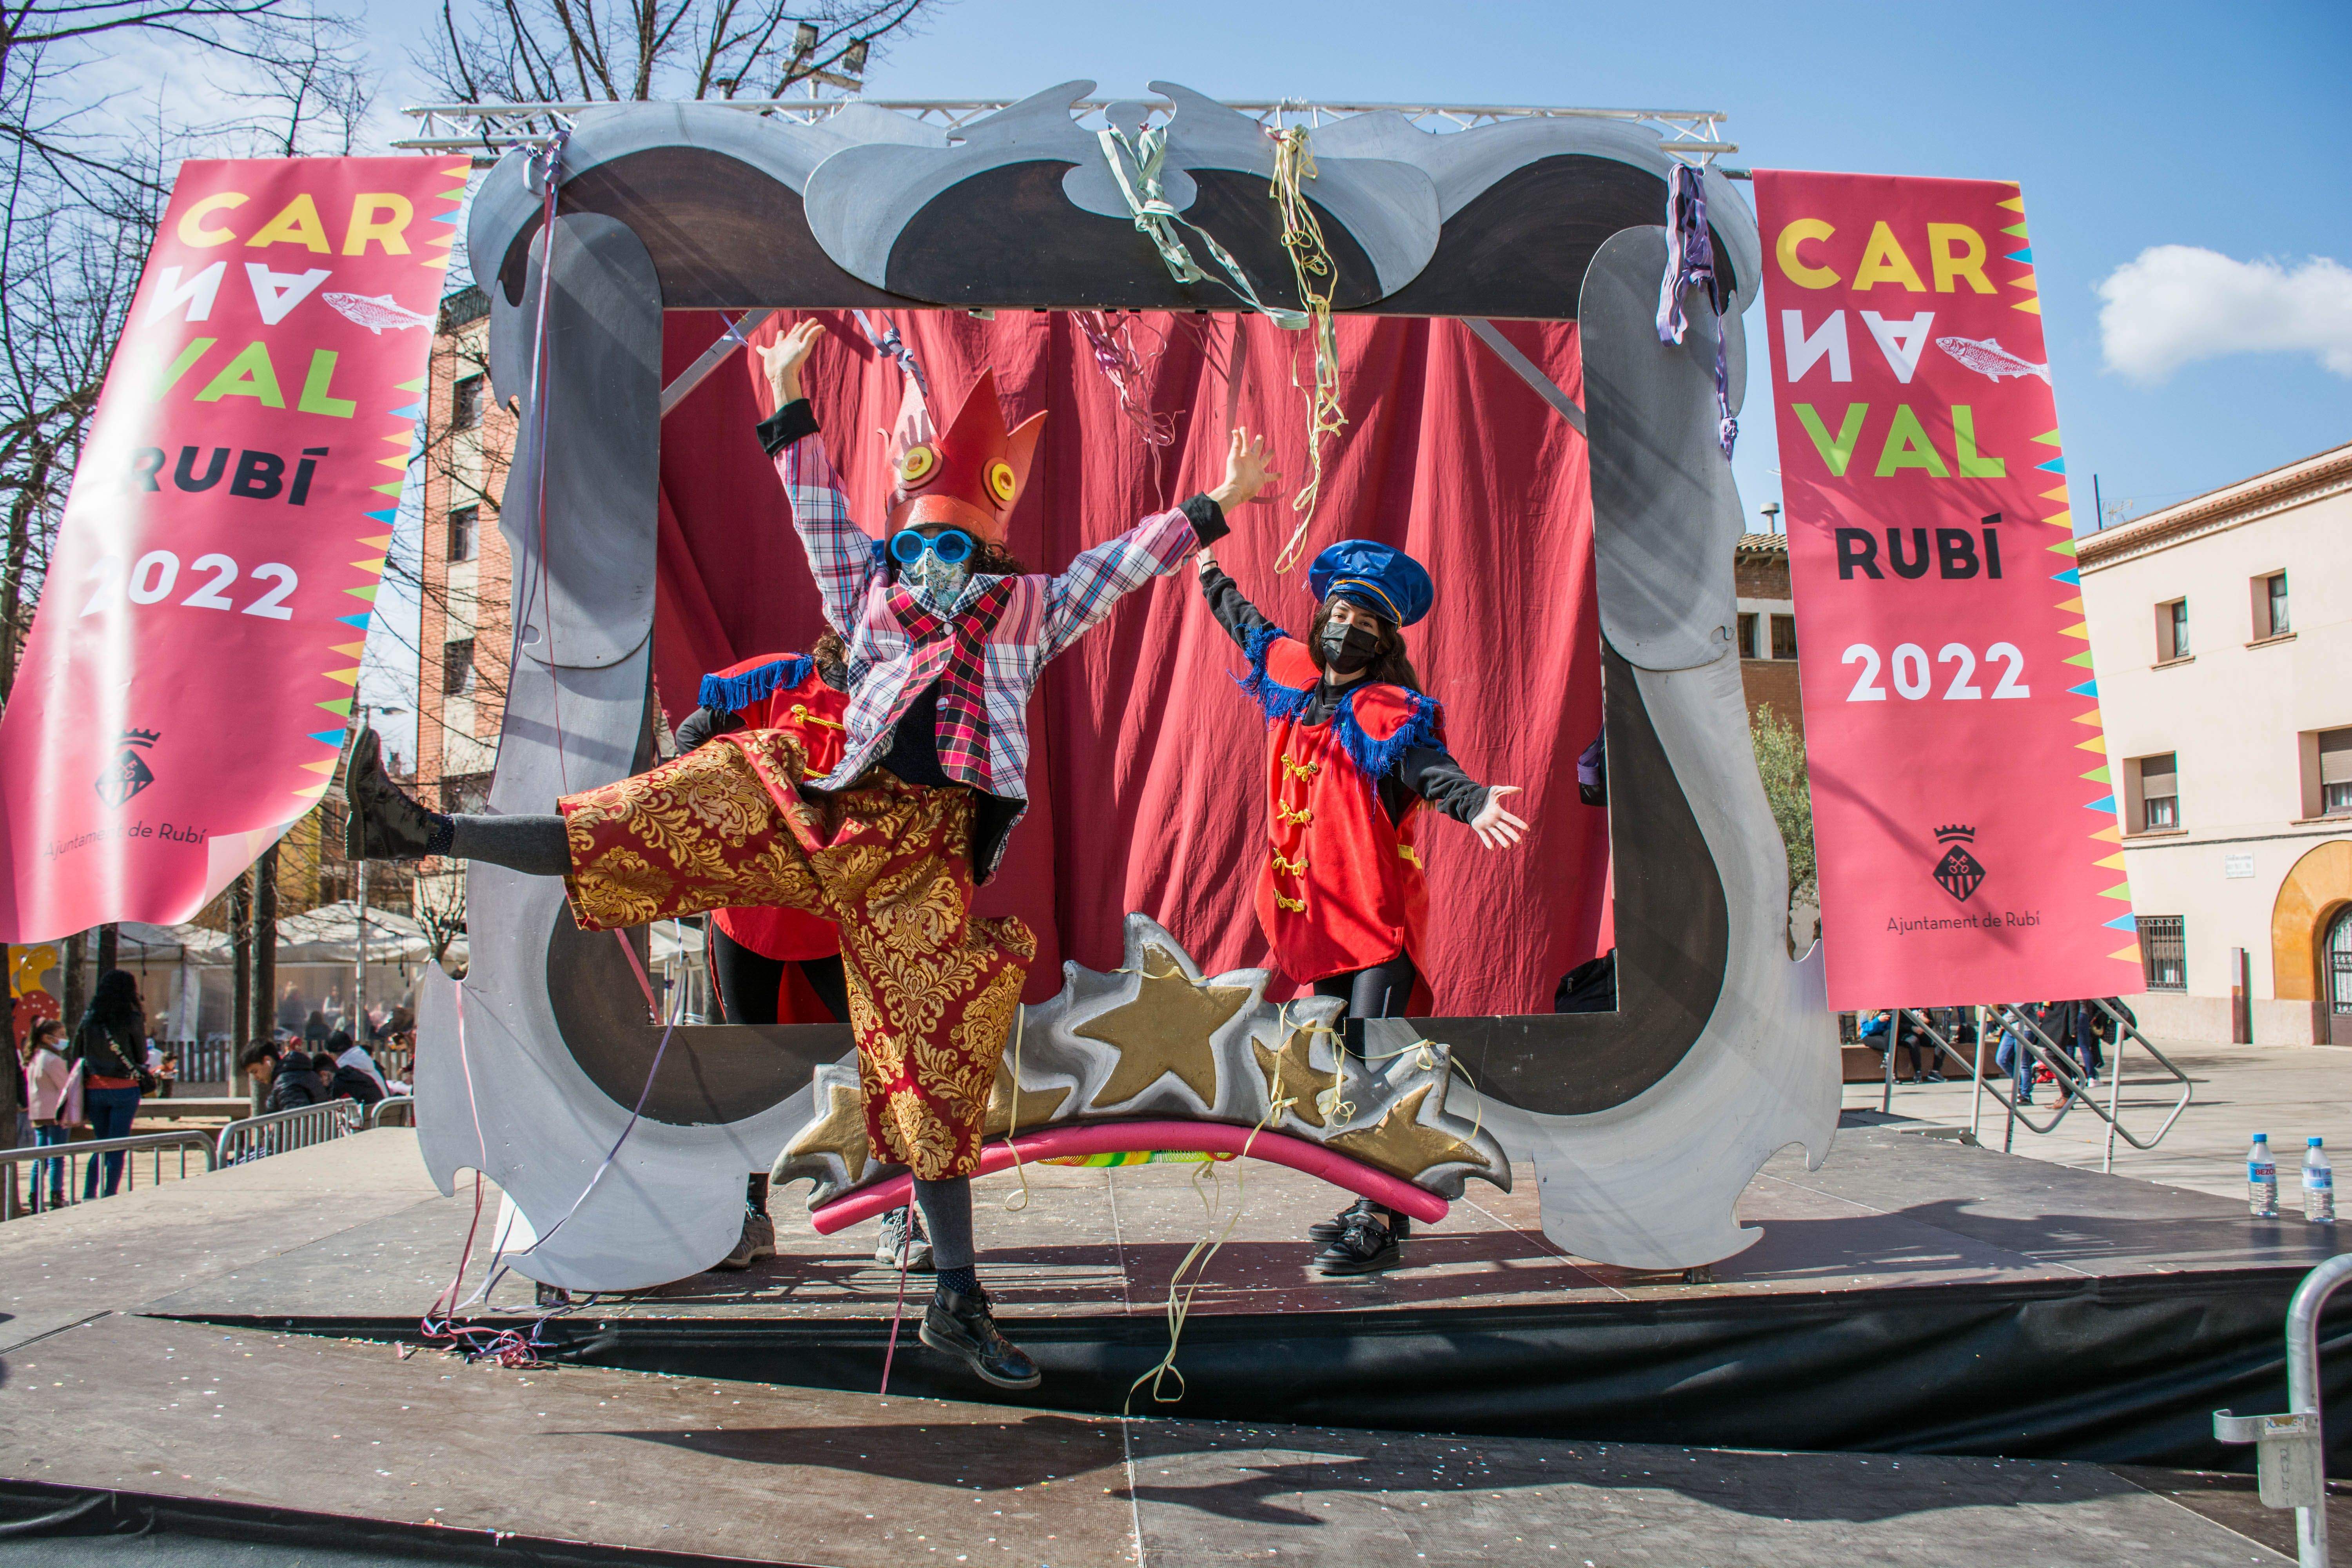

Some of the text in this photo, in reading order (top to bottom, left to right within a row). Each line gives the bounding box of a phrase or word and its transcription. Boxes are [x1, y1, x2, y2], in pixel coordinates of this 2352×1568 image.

[178, 192, 414, 256] CAR
[1776, 218, 1998, 294] CAR
[138, 338, 357, 419] VAL
[1791, 403, 2006, 477] VAL
[120, 445, 330, 506] RUBÍ
[1835, 512, 2002, 580] RUBÍ
[78, 550, 298, 621] 2022
[1841, 642, 2031, 702] 2022
[128, 820, 153, 838] de
[158, 822, 207, 845] Rubí
[1887, 910, 2041, 935] Ajuntament de Rubí
